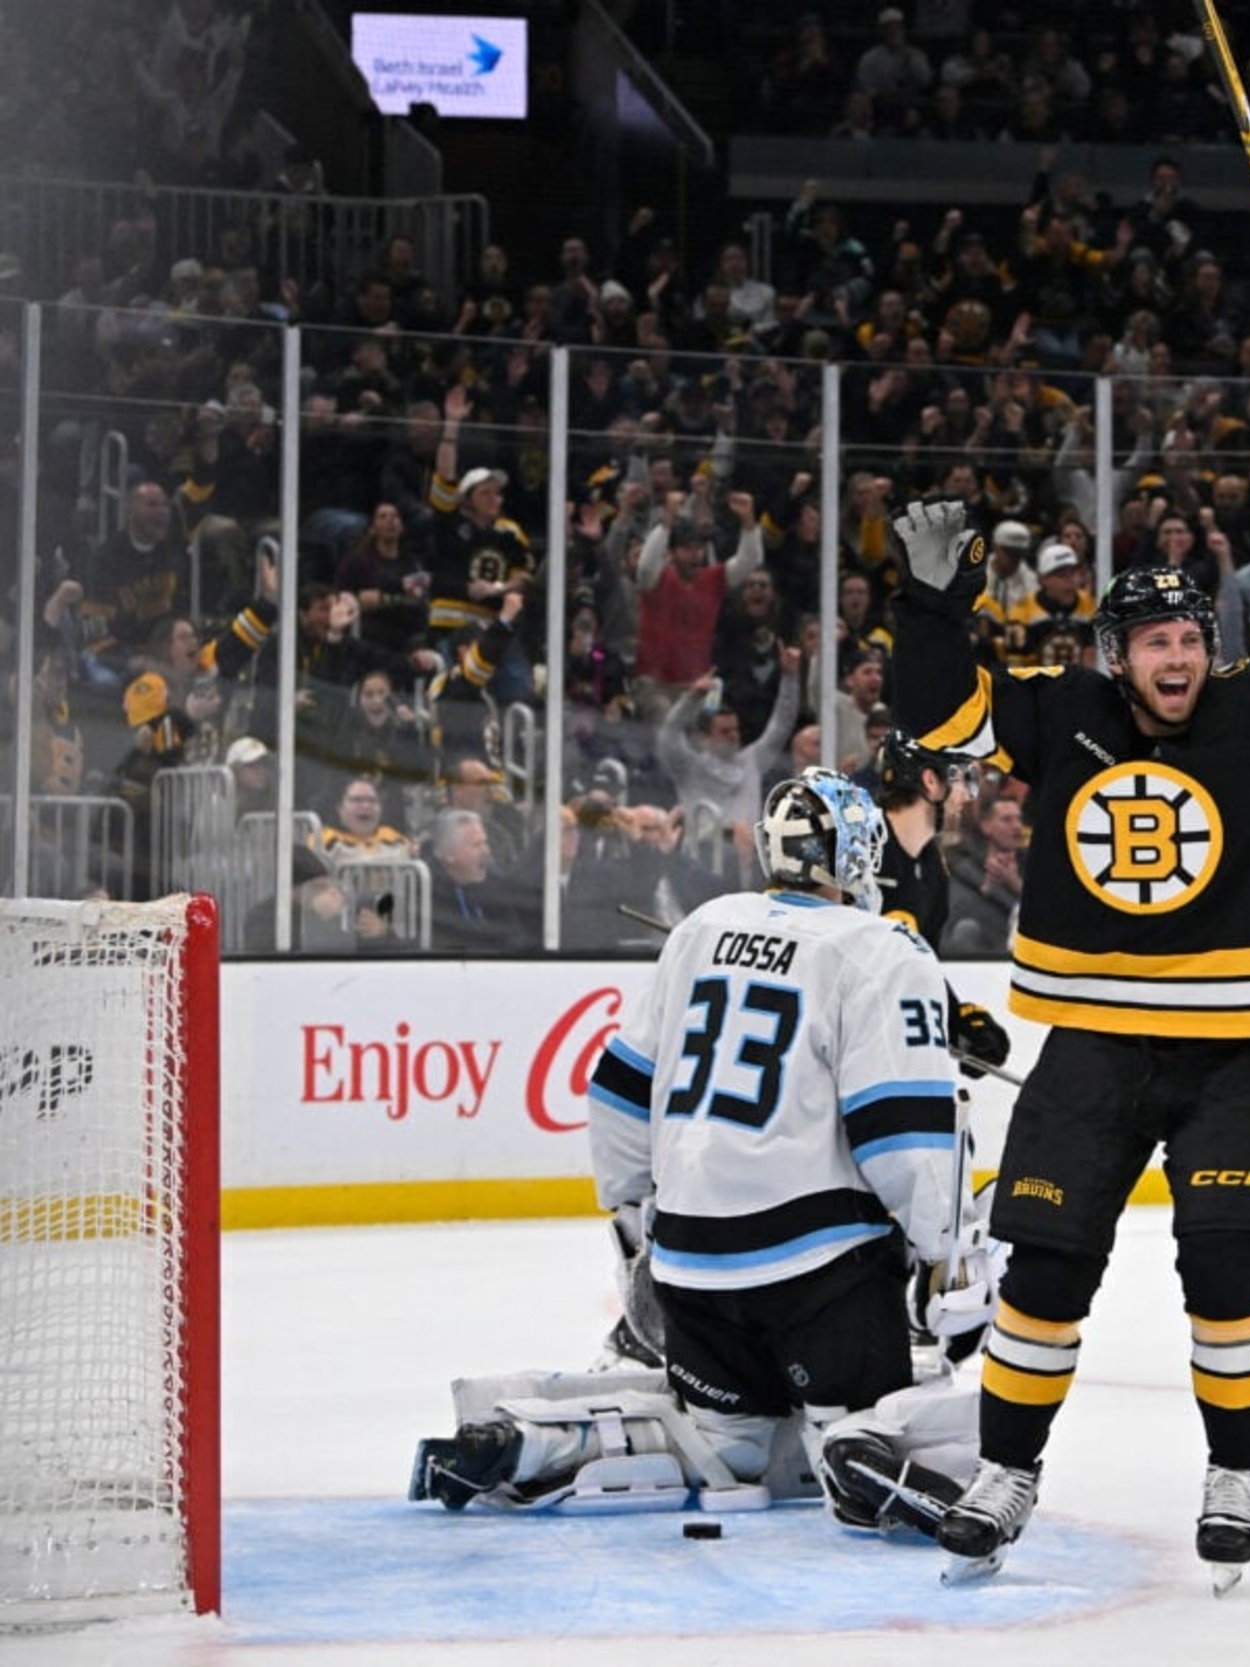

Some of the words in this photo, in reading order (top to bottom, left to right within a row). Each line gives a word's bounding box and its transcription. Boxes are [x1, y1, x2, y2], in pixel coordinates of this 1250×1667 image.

[1106, 796, 1181, 882] B
[712, 930, 799, 976] COSSA
[665, 975, 803, 1134] 33
[899, 998, 948, 1049] 33
[300, 1021, 503, 1121] Enjoy
